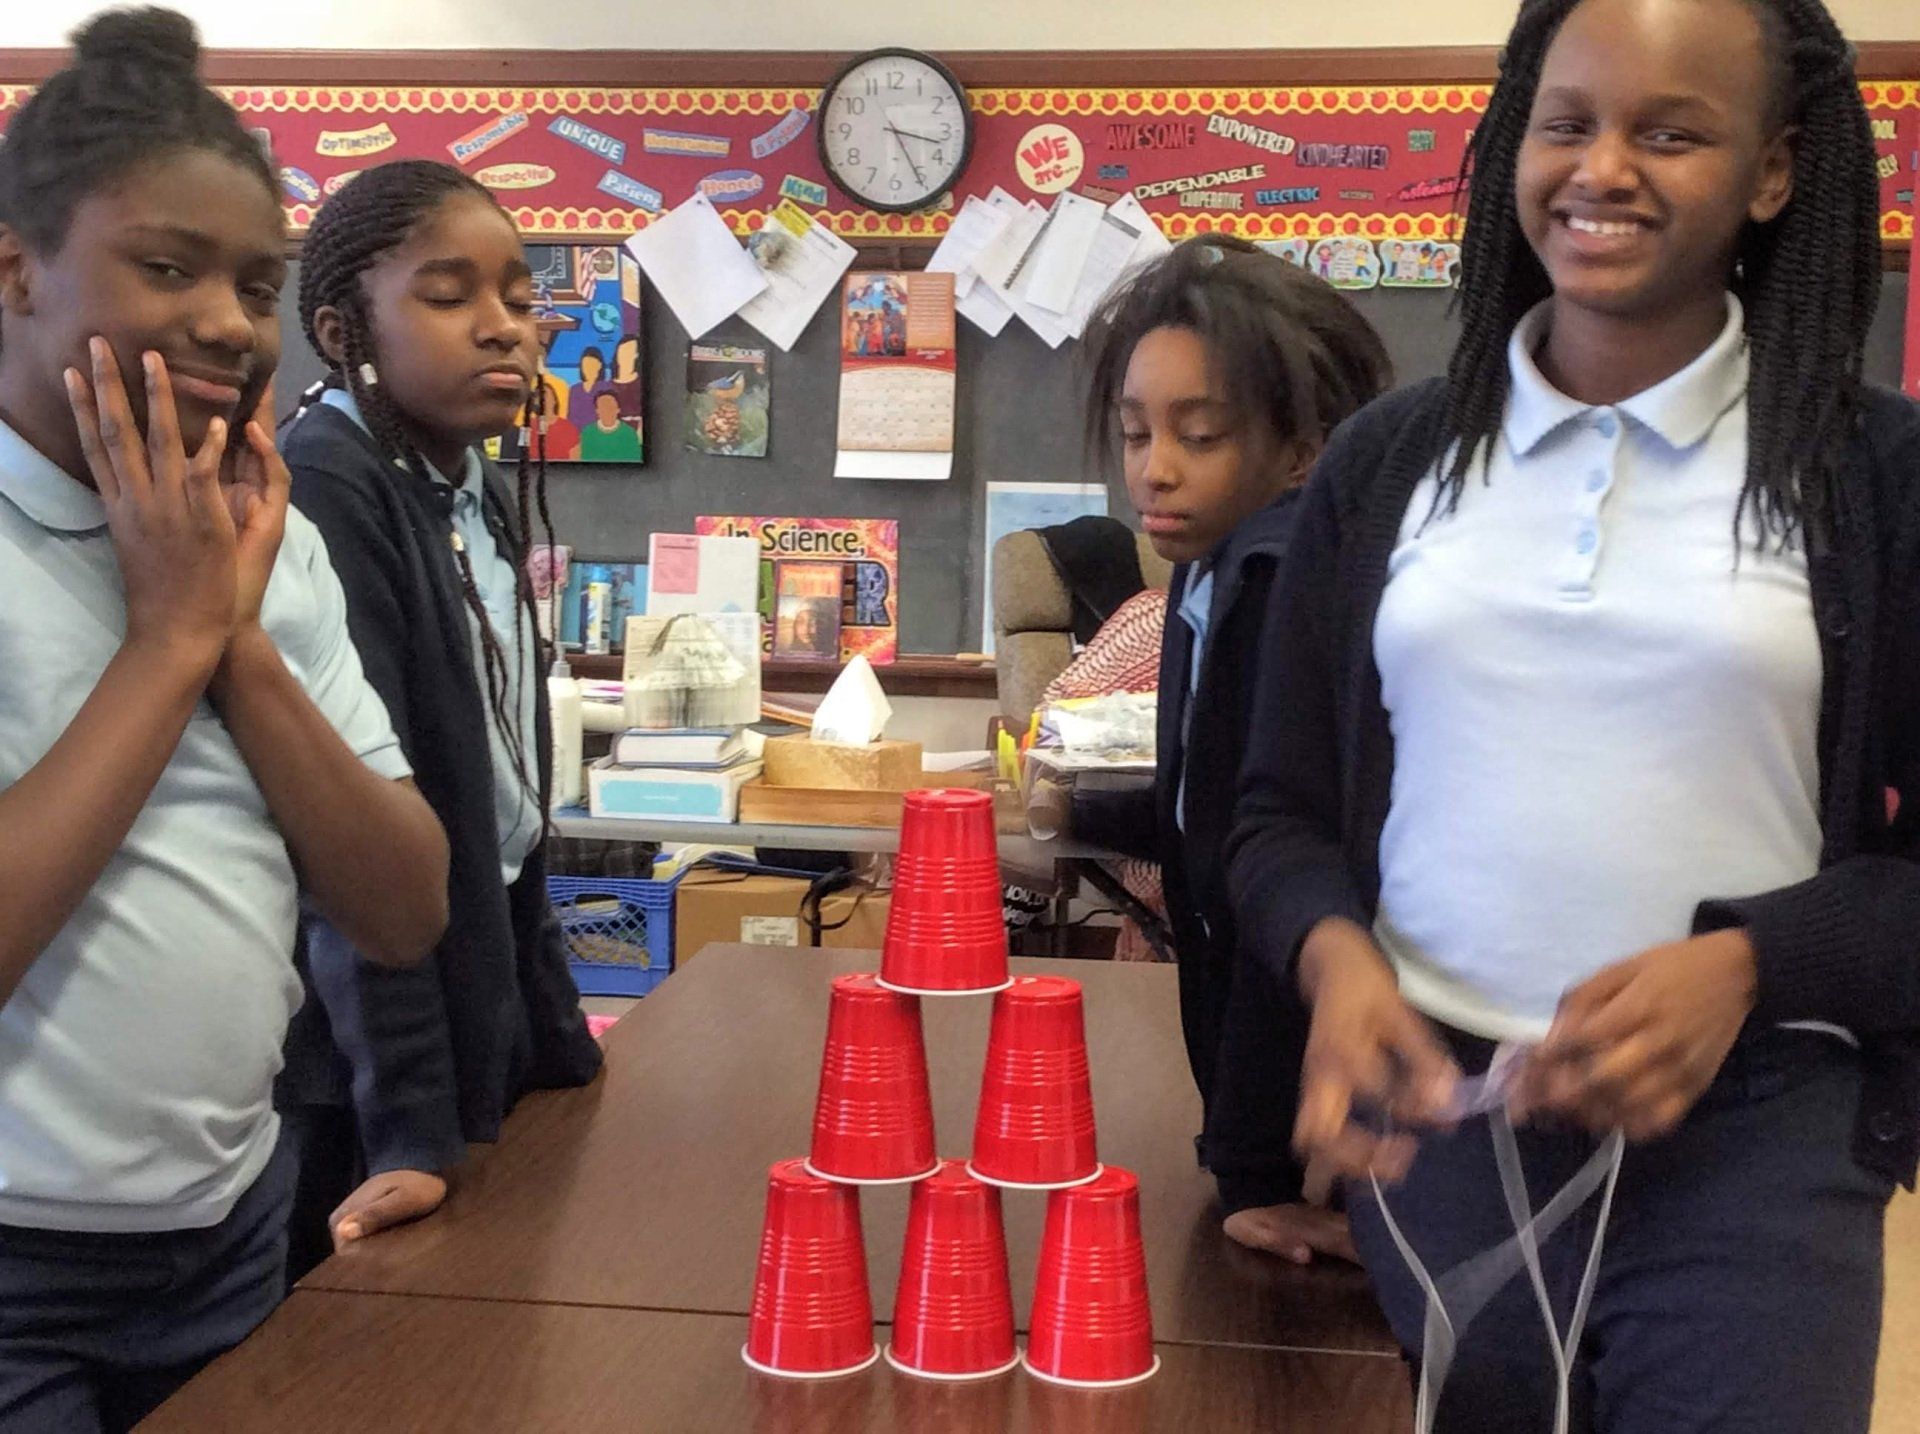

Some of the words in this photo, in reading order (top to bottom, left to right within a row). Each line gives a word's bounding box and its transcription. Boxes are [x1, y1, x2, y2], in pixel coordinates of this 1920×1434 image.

[865, 77, 879, 96] 11
[886, 71, 905, 91] 12
[916, 78, 923, 97] 1
[846, 97, 866, 116] 10
[931, 96, 945, 115] 2
[838, 122, 853, 141] 9
[939, 122, 952, 142] 3
[1107, 123, 1197, 150] AWESOME
[1206, 114, 1296, 155] EMPOWERED
[847, 147, 861, 166] 8
[931, 148, 944, 166] 4
[1020, 136, 1070, 170] WE
[1297, 143, 1390, 170] KINDHEARTED
[866, 166, 879, 185] 7
[889, 172, 903, 191] 6
[914, 165, 928, 185] 5
[1134, 164, 1267, 199] DEPENDABLE
[1256, 186, 1321, 205] ELECTRIC
[760, 523, 866, 556] Science,
